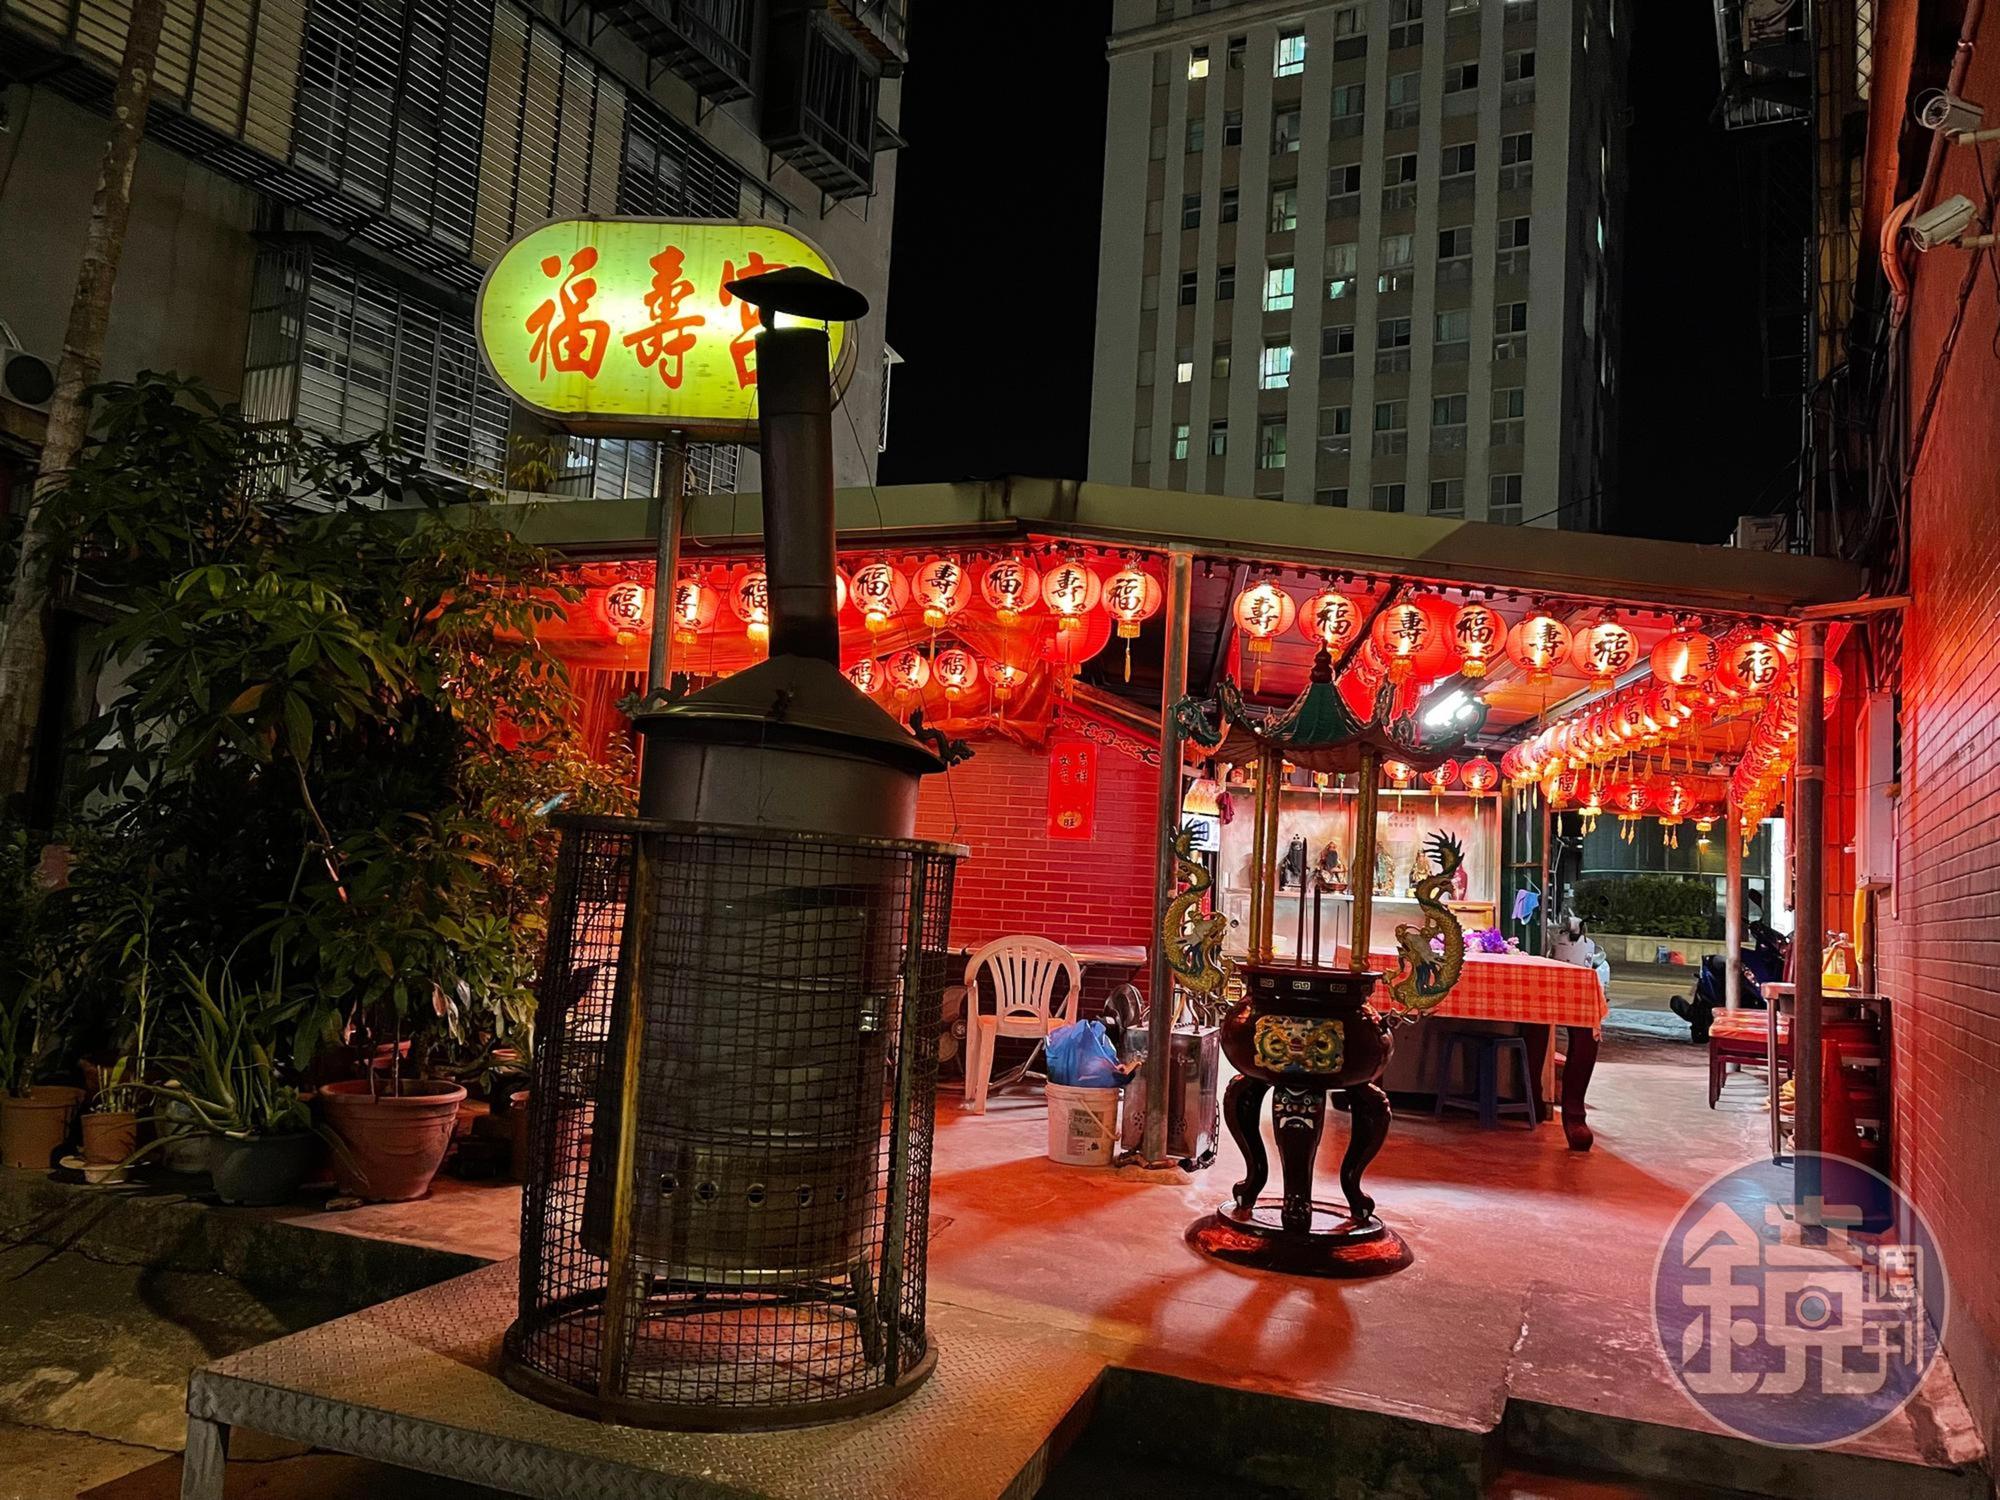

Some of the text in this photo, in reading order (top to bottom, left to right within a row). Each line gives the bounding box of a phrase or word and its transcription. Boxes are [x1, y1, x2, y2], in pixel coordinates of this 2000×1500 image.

[857, 566, 889, 597] 福
[925, 563, 958, 594] 壽
[989, 565, 1021, 595] 福
[1052, 569, 1084, 602] 壽
[1108, 577, 1140, 610] 福
[608, 586, 640, 618] 福
[1245, 596, 1279, 629] 壽
[1316, 601, 1352, 636] 福
[1392, 611, 1427, 645] 壽
[1456, 611, 1495, 644] 福
[1529, 622, 1565, 657] 壽
[941, 652, 967, 676] 福
[1594, 632, 1630, 668] 福
[1738, 649, 1778, 684] 福
